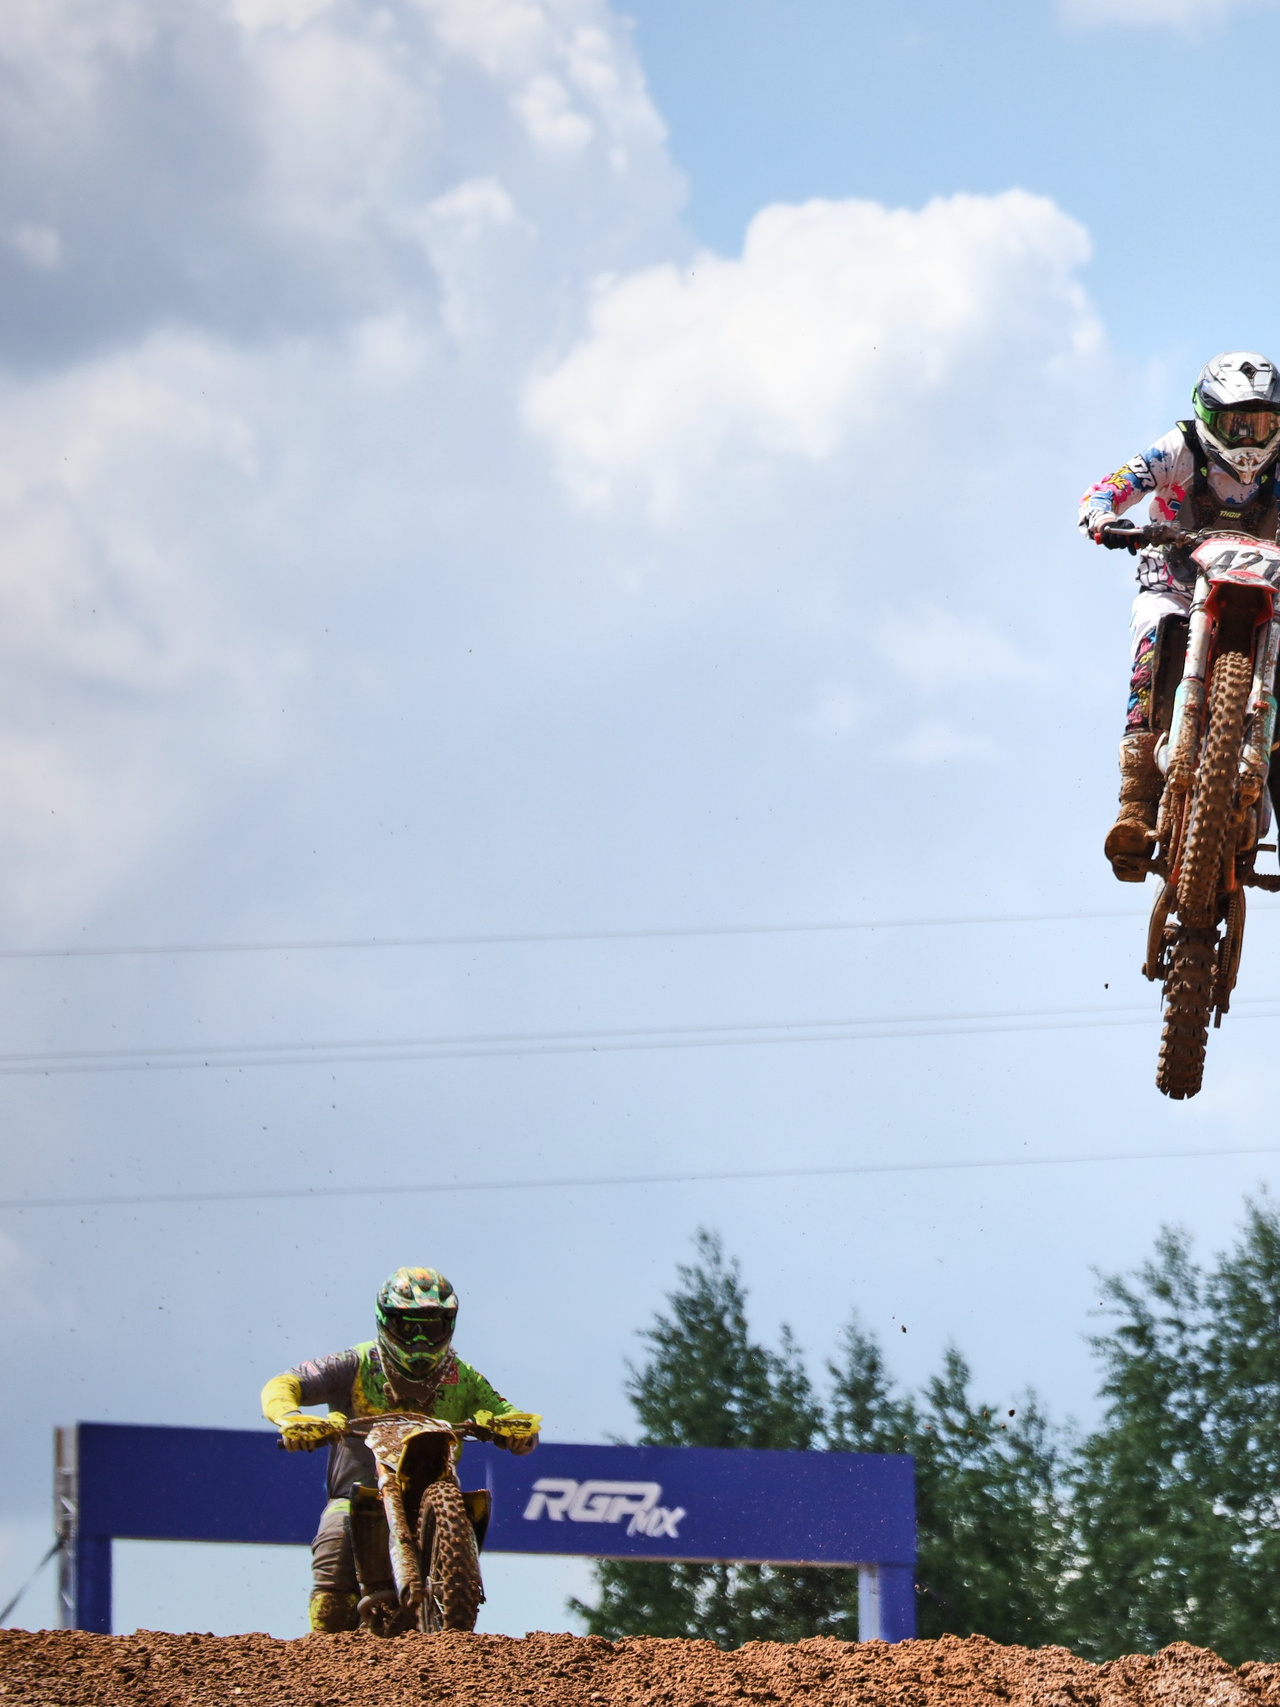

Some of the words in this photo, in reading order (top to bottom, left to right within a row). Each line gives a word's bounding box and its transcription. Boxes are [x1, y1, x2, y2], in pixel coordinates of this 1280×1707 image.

[1220, 510, 1241, 519] THOR
[523, 1477, 662, 1523] RGP
[626, 1506, 687, 1538] MX
